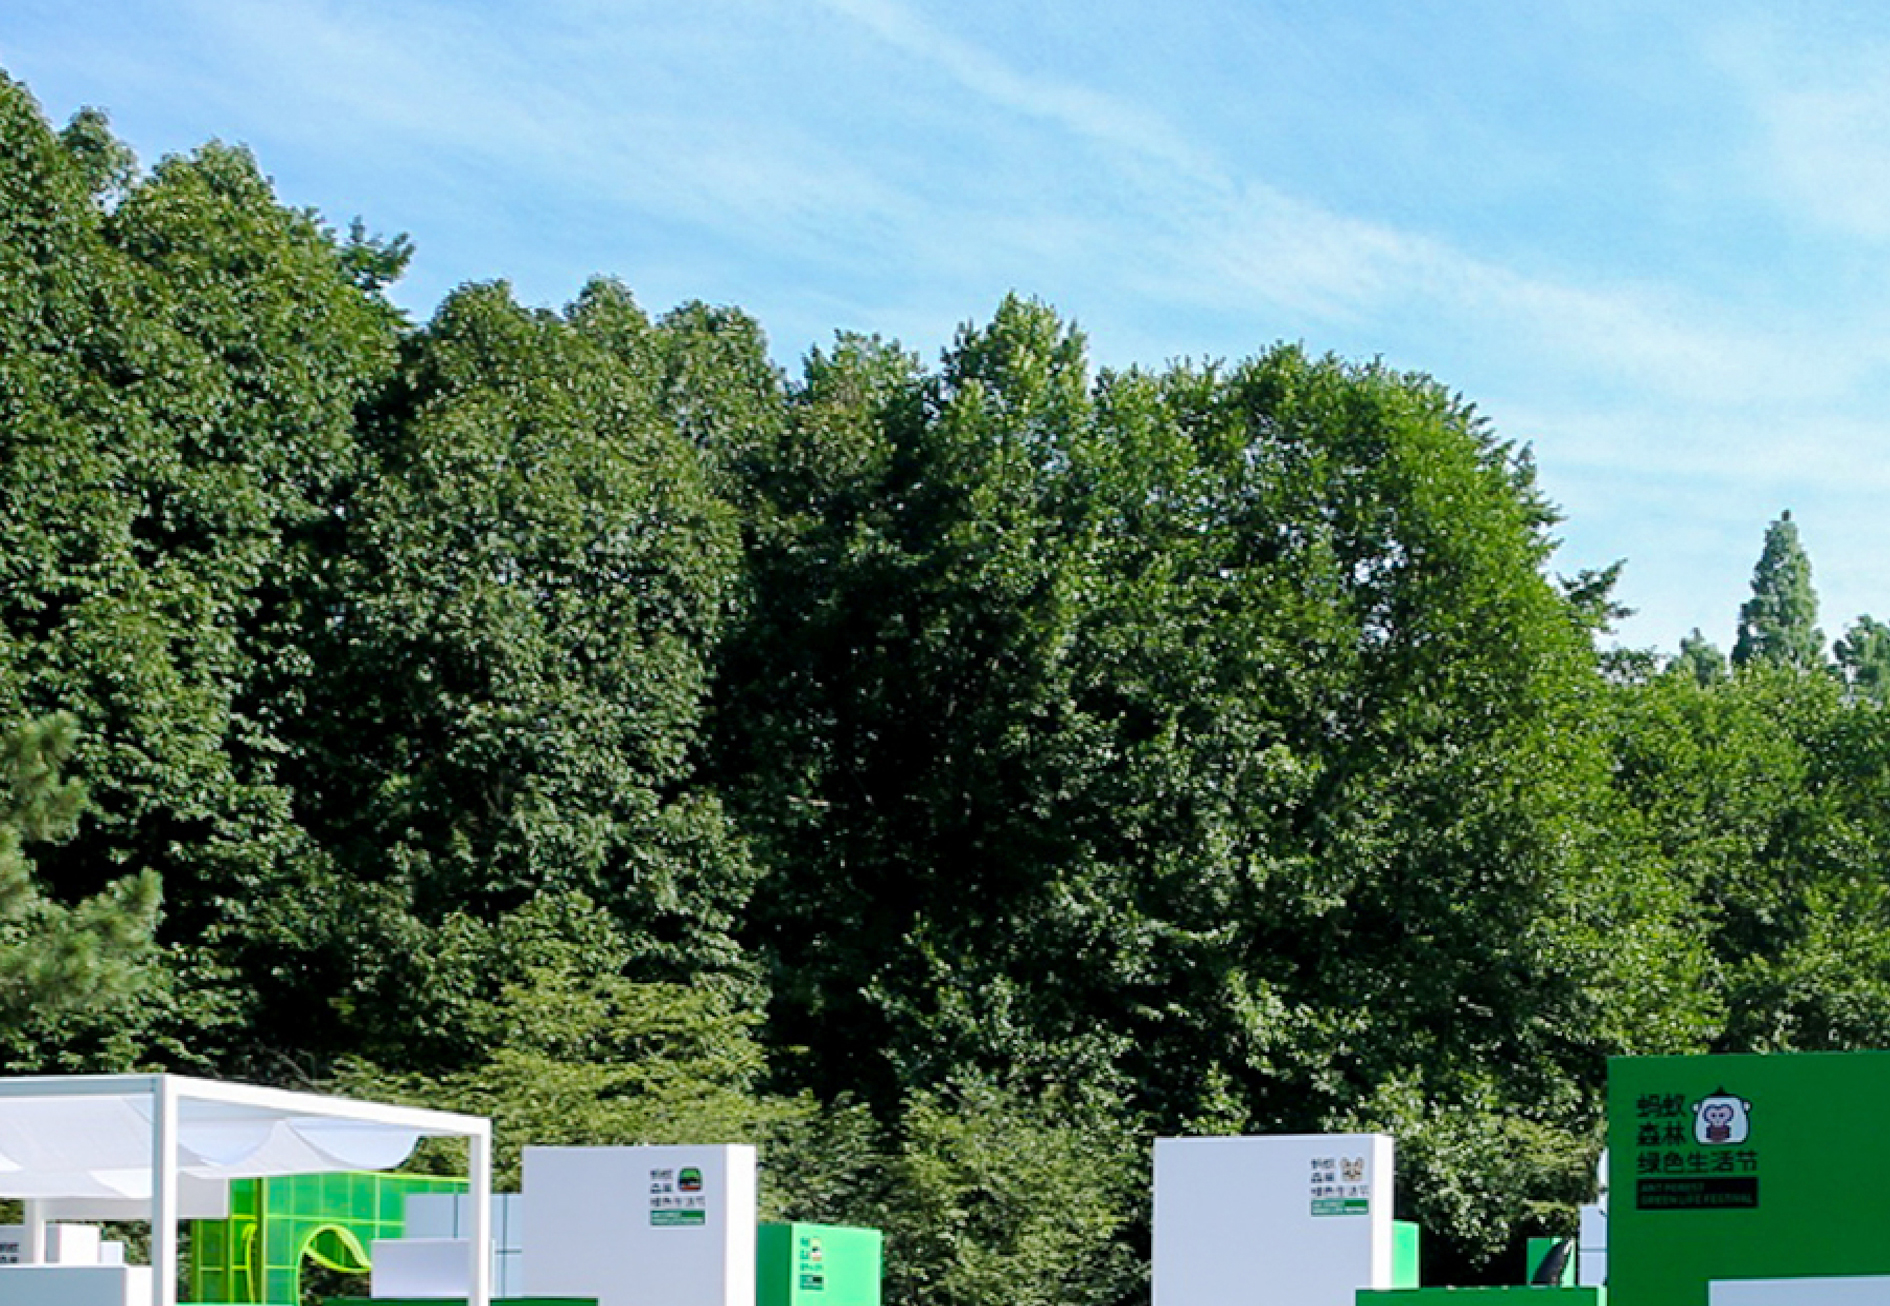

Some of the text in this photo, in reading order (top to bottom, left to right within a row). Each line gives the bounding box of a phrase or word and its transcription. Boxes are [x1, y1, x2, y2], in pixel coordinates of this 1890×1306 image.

[1636, 1093, 1687, 1118] 蚂蚁
[1636, 1121, 1687, 1146] 森林
[1636, 1150, 1759, 1174] 绿色生活节
